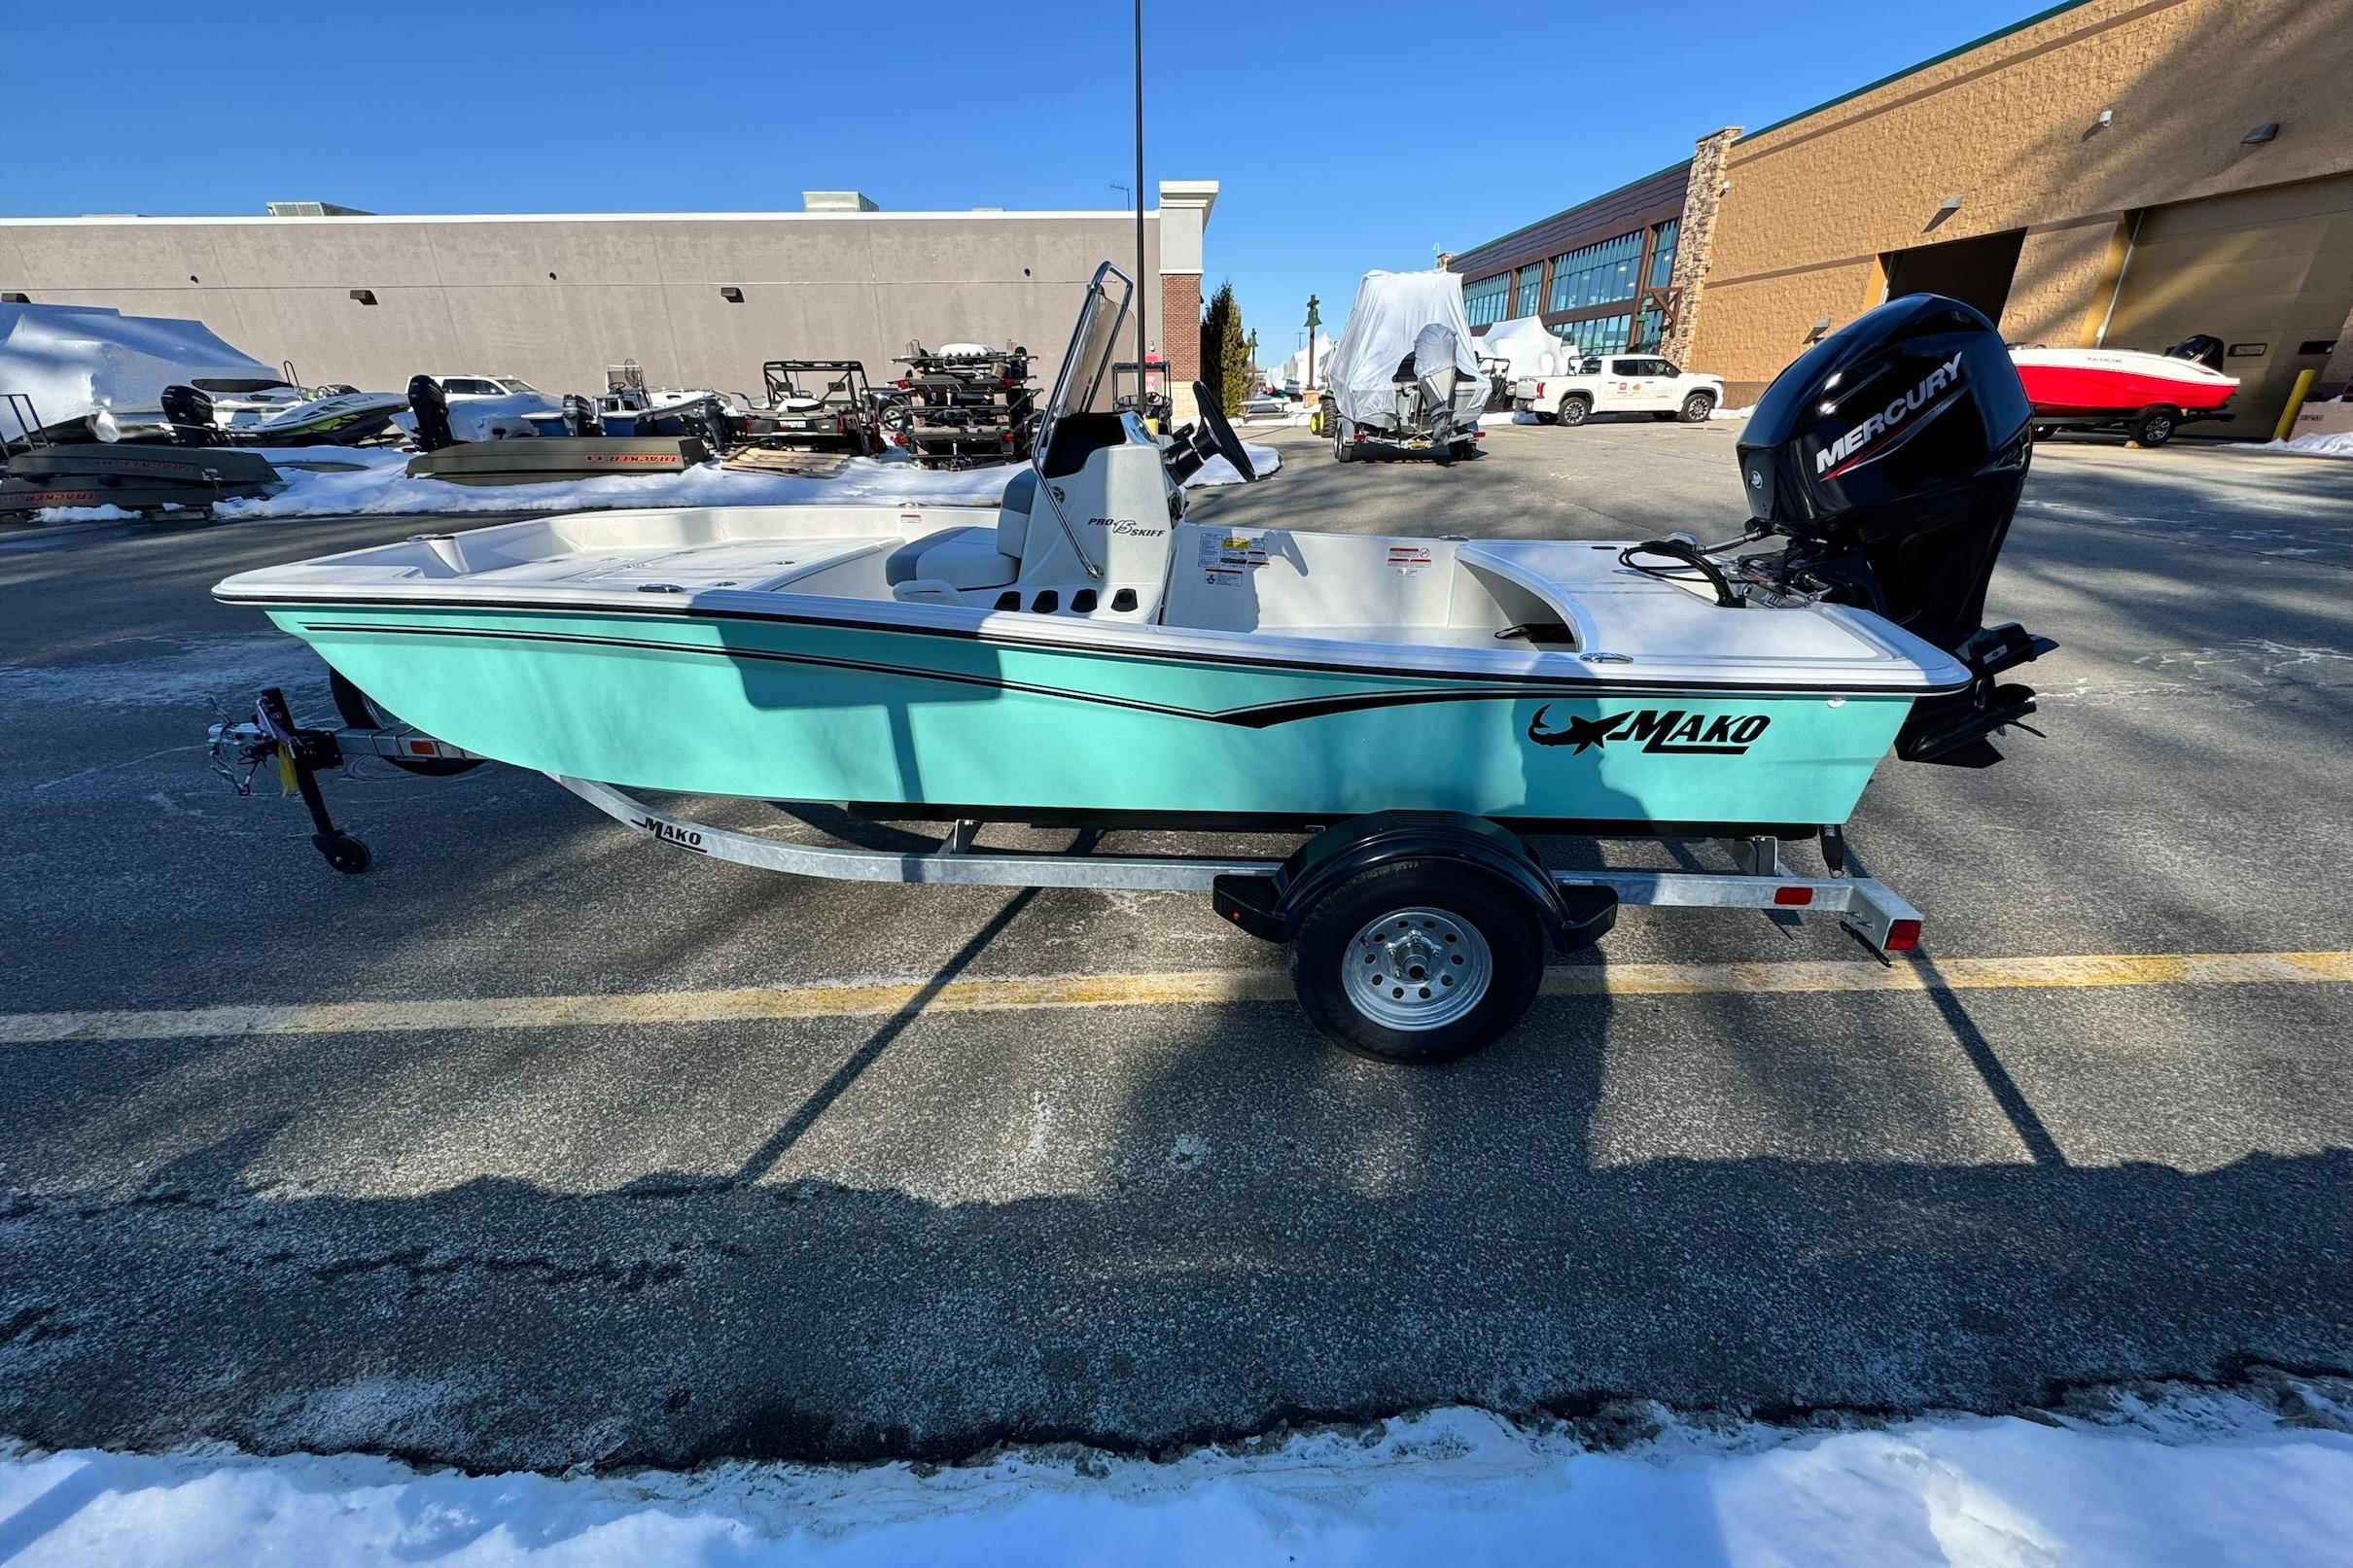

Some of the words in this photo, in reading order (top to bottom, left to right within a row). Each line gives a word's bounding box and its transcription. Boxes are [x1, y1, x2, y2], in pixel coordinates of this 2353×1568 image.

[1816, 351, 1963, 473] MERCURY
[1112, 519, 1137, 534] 15
[1606, 711, 1771, 755] MAKO
[631, 817, 707, 853] MAKO
